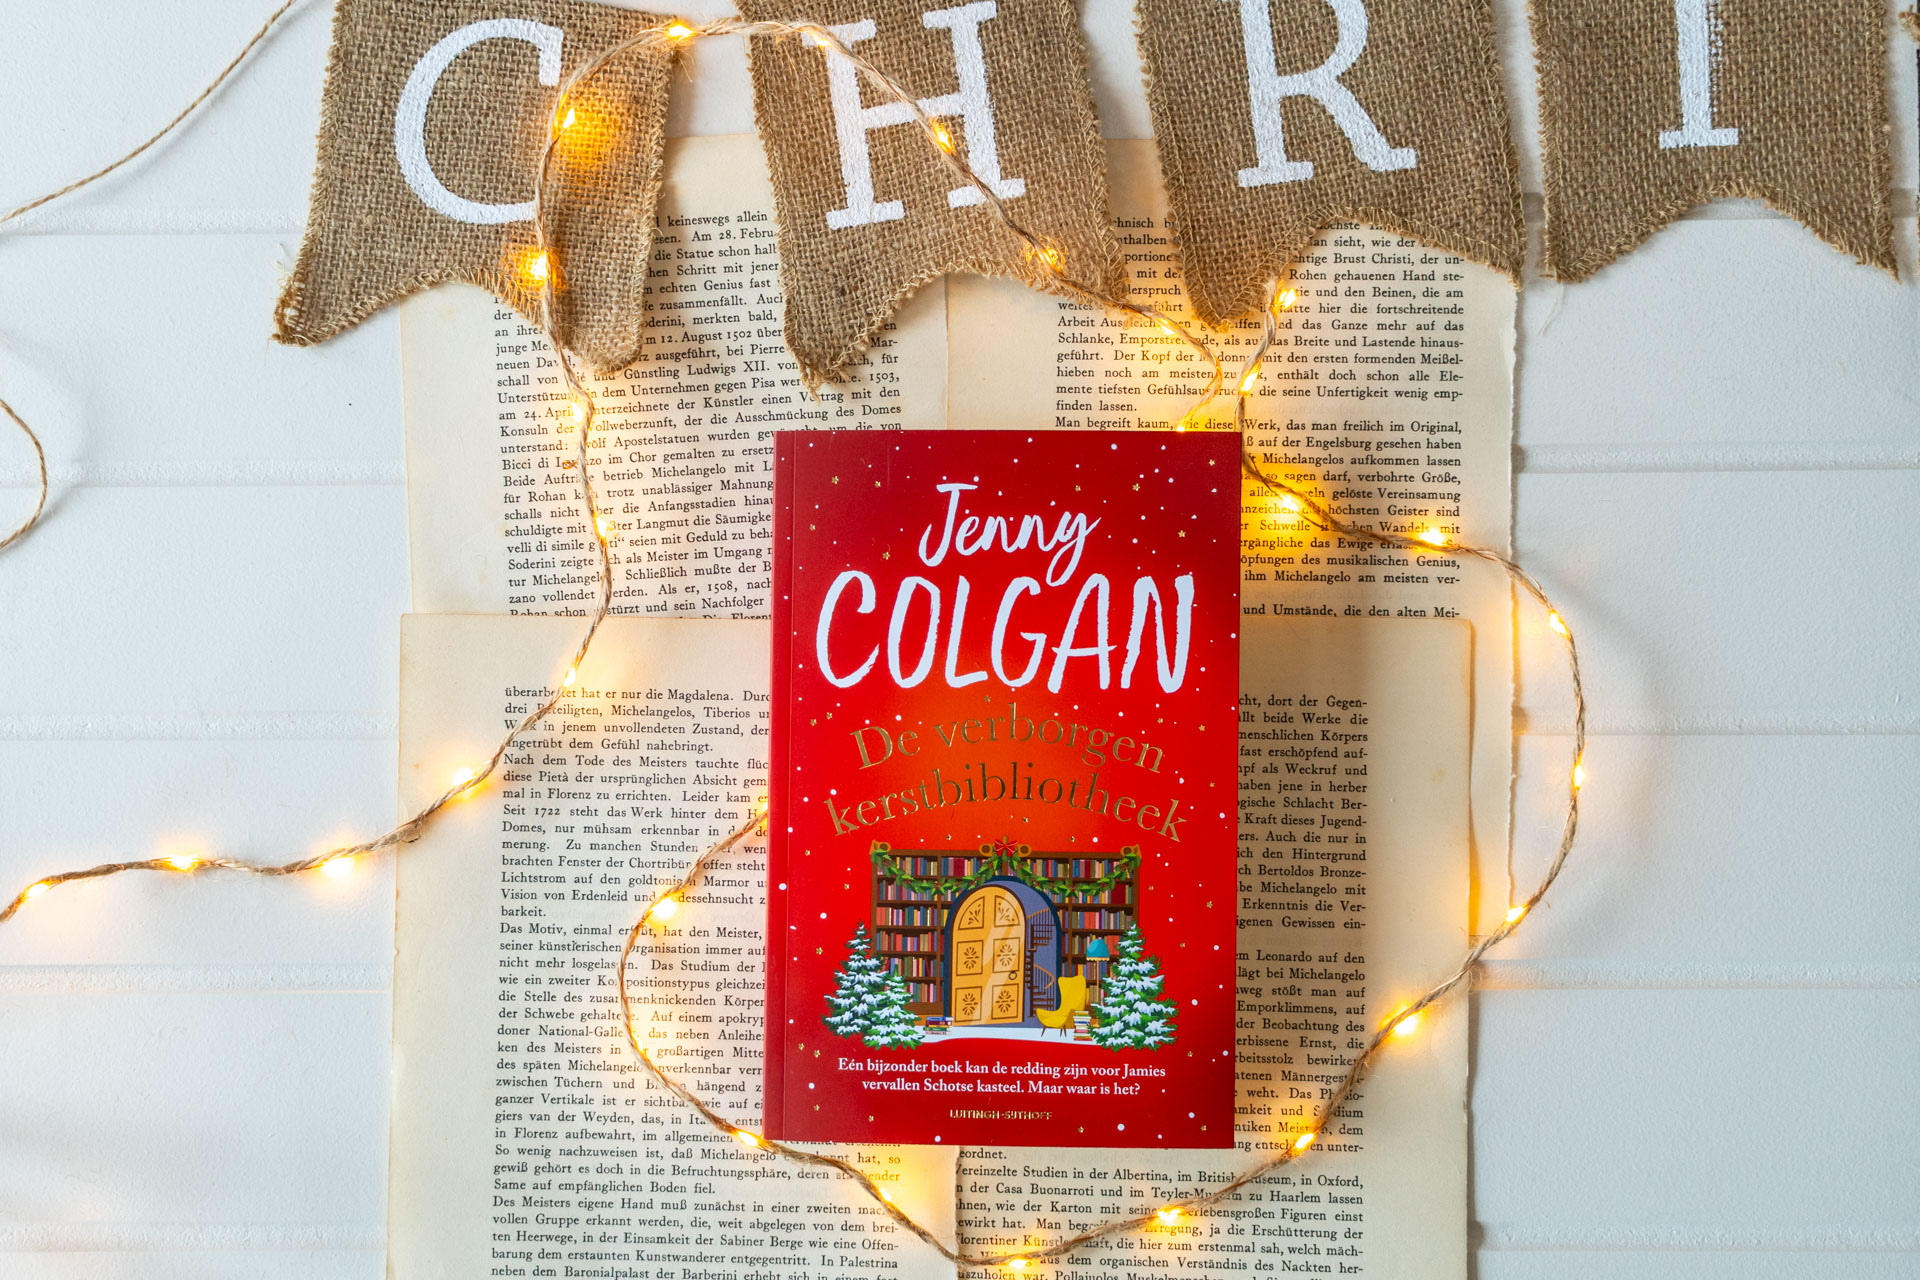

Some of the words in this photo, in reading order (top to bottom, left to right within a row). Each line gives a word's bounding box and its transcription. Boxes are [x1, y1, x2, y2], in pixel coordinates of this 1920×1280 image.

[667, 215, 730, 227] keineswegs
[737, 210, 768, 222] allein
[1333, 253, 1366, 264] Brust
[1371, 253, 1415, 266] Christi,
[1420, 253, 1439, 264] der
[676, 264, 716, 276] Schritt
[723, 262, 743, 273] mit
[751, 261, 779, 275] jener
[1288, 268, 1327, 280] Rohen
[1334, 269, 1396, 283] gehauenen
[1402, 270, 1436, 281] Hand
[1443, 273, 1464, 281] ste-
[681, 331, 723, 345] August
[756, 326, 782, 338] über
[655, 347, 720, 363] ausgeführt,
[726, 345, 744, 356] bei
[750, 343, 785, 355] Pierre
[624, 366, 680, 380] Günstling
[686, 363, 736, 377] Ludwigs
[777, 362, 798, 370] von
[1056, 366, 1094, 377] hieben
[1105, 367, 1132, 378] noch
[1169, 368, 1214, 380] meisten
[1277, 368, 1319, 380] enthält
[1329, 369, 1357, 380] doch
[1366, 370, 1399, 381] schon
[1409, 370, 1430, 381] alle
[1439, 370, 1464, 382] Ele-
[602, 387, 626, 397] dem
[631, 382, 710, 396] Unternehmen
[714, 382, 747, 394] gegen
[751, 377, 776, 388] Pisa
[1056, 399, 1092, 411] finden
[1099, 400, 1137, 411] lassen.
[1286, 419, 1306, 431] das
[1311, 423, 1337, 431] man
[1343, 420, 1384, 431] freilich
[1389, 421, 1405, 432] im
[1410, 421, 1462, 435] Original,
[614, 434, 700, 450] Apostelstatuen
[707, 429, 750, 441] wurden
[1258, 436, 1278, 447] auf
[1281, 436, 1301, 447] der
[1305, 436, 1372, 452] Engelsburg
[1375, 437, 1421, 452] gesehen
[1426, 438, 1462, 449] haben
[502, 458, 531, 470] Bicci
[538, 457, 549, 469] di
[608, 454, 623, 464] im
[629, 451, 657, 463] Chor
[663, 448, 715, 464] gemalten
[503, 475, 536, 487] Beide
[603, 468, 643, 481] betrieb
[651, 463, 726, 478] Michelangelo
[734, 461, 755, 473] mit
[919, 483, 1101, 587] Jenny
[1244, 569, 1267, 581] ihm
[1274, 570, 1351, 585] Michelangelo
[1383, 572, 1429, 584] meisten
[1436, 576, 1460, 584] ver-
[816, 570, 1194, 693] COLGAN
[1263, 711, 1294, 724] beide
[1301, 712, 1341, 724] Werke
[1349, 713, 1368, 725] die
[850, 726, 920, 770] De
[934, 702, 1163, 773] verborgen
[504, 753, 534, 765] Nach
[542, 754, 567, 765] dem
[575, 754, 605, 766] Tode
[612, 755, 631, 766] des
[639, 756, 687, 768] Meisters
[695, 758, 739, 769] tauchte
[1262, 762, 1279, 774] als
[1285, 762, 1337, 775] Weckruf
[1345, 764, 1368, 776] und
[503, 770, 532, 782] diese
[538, 771, 569, 782] Pietà
[575, 771, 594, 783] der
[600, 773, 686, 787] ursprünglichen
[692, 774, 737, 786] Absicht
[824, 762, 1187, 842] kerstbibliotheek
[503, 804, 526, 815] Seit
[570, 805, 599, 816] steht
[607, 806, 626, 817] das
[631, 806, 662, 818] Werk
[671, 807, 706, 819] hinter
[714, 808, 738, 819] dem
[1257, 864, 1314, 877] Bertoldos
[1320, 865, 1367, 878] Bronze-
[501, 905, 546, 917] barkeit.
[1256, 949, 1312, 962] Leonardo
[1318, 952, 1338, 963] auf
[1344, 952, 1365, 964] den
[1266, 967, 1284, 979] bei
[1289, 967, 1366, 984] Michelangelo
[1237, 1000, 1337, 1016] Emporklimmens,
[1345, 1004, 1366, 1015] auf
[838, 1057, 864, 1071] Eén
[867, 1058, 928, 1075] bijzonder
[931, 1060, 963, 1073] boek
[966, 1060, 989, 1073] kan
[992, 1061, 1008, 1074] de
[1011, 1062, 1061, 1079] redding
[1064, 1064, 1088, 1079] zijn
[1091, 1067, 1121, 1076] voor
[1122, 1063, 1166, 1079] Jamies
[862, 1078, 920, 1091] vervallen
[924, 1078, 973, 1092] Schotse
[977, 1079, 1024, 1093] kasteel.
[1028, 1080, 1063, 1093] Maar
[1066, 1086, 1097, 1094] waar
[1100, 1083, 1110, 1094] is
[1114, 1082, 1140, 1095] het?
[495, 1127, 506, 1138] in
[514, 1127, 558, 1139] Florenz
[565, 1128, 635, 1142] aufbewahrt,
[643, 1130, 657, 1141] im
[665, 1130, 733, 1144] allgemeinen
[494, 1178, 526, 1190] Same
[532, 1179, 552, 1190] auf
[558, 1180, 643, 1194] empfänglichen
[650, 1181, 686, 1193] Boden
[694, 1182, 715, 1194] fiel.
[970, 1181, 990, 1193] der
[996, 1182, 1023, 1194] Casa
[1030, 1183, 1094, 1196] Buonarroti
[1100, 1185, 1123, 1197] und
[1130, 1186, 1144, 1198] im
[492, 1213, 528, 1224] vollen
[535, 1213, 579, 1228] Gruppe
[586, 1214, 631, 1226] erkannt
[638, 1215, 683, 1230] werden,
[690, 1216, 711, 1230] die,
[718, 1217, 743, 1229] weit
[749, 1218, 806, 1233] abgelegen
[813, 1223, 834, 1231] von
[841, 1220, 865, 1232] dem
[873, 1222, 897, 1233] brei-
[1209, 1223, 1220, 1238] ja
[1227, 1223, 1245, 1236] die
[1251, 1224, 1338, 1242] Erschütterung
[1344, 1227, 1363, 1239] der
